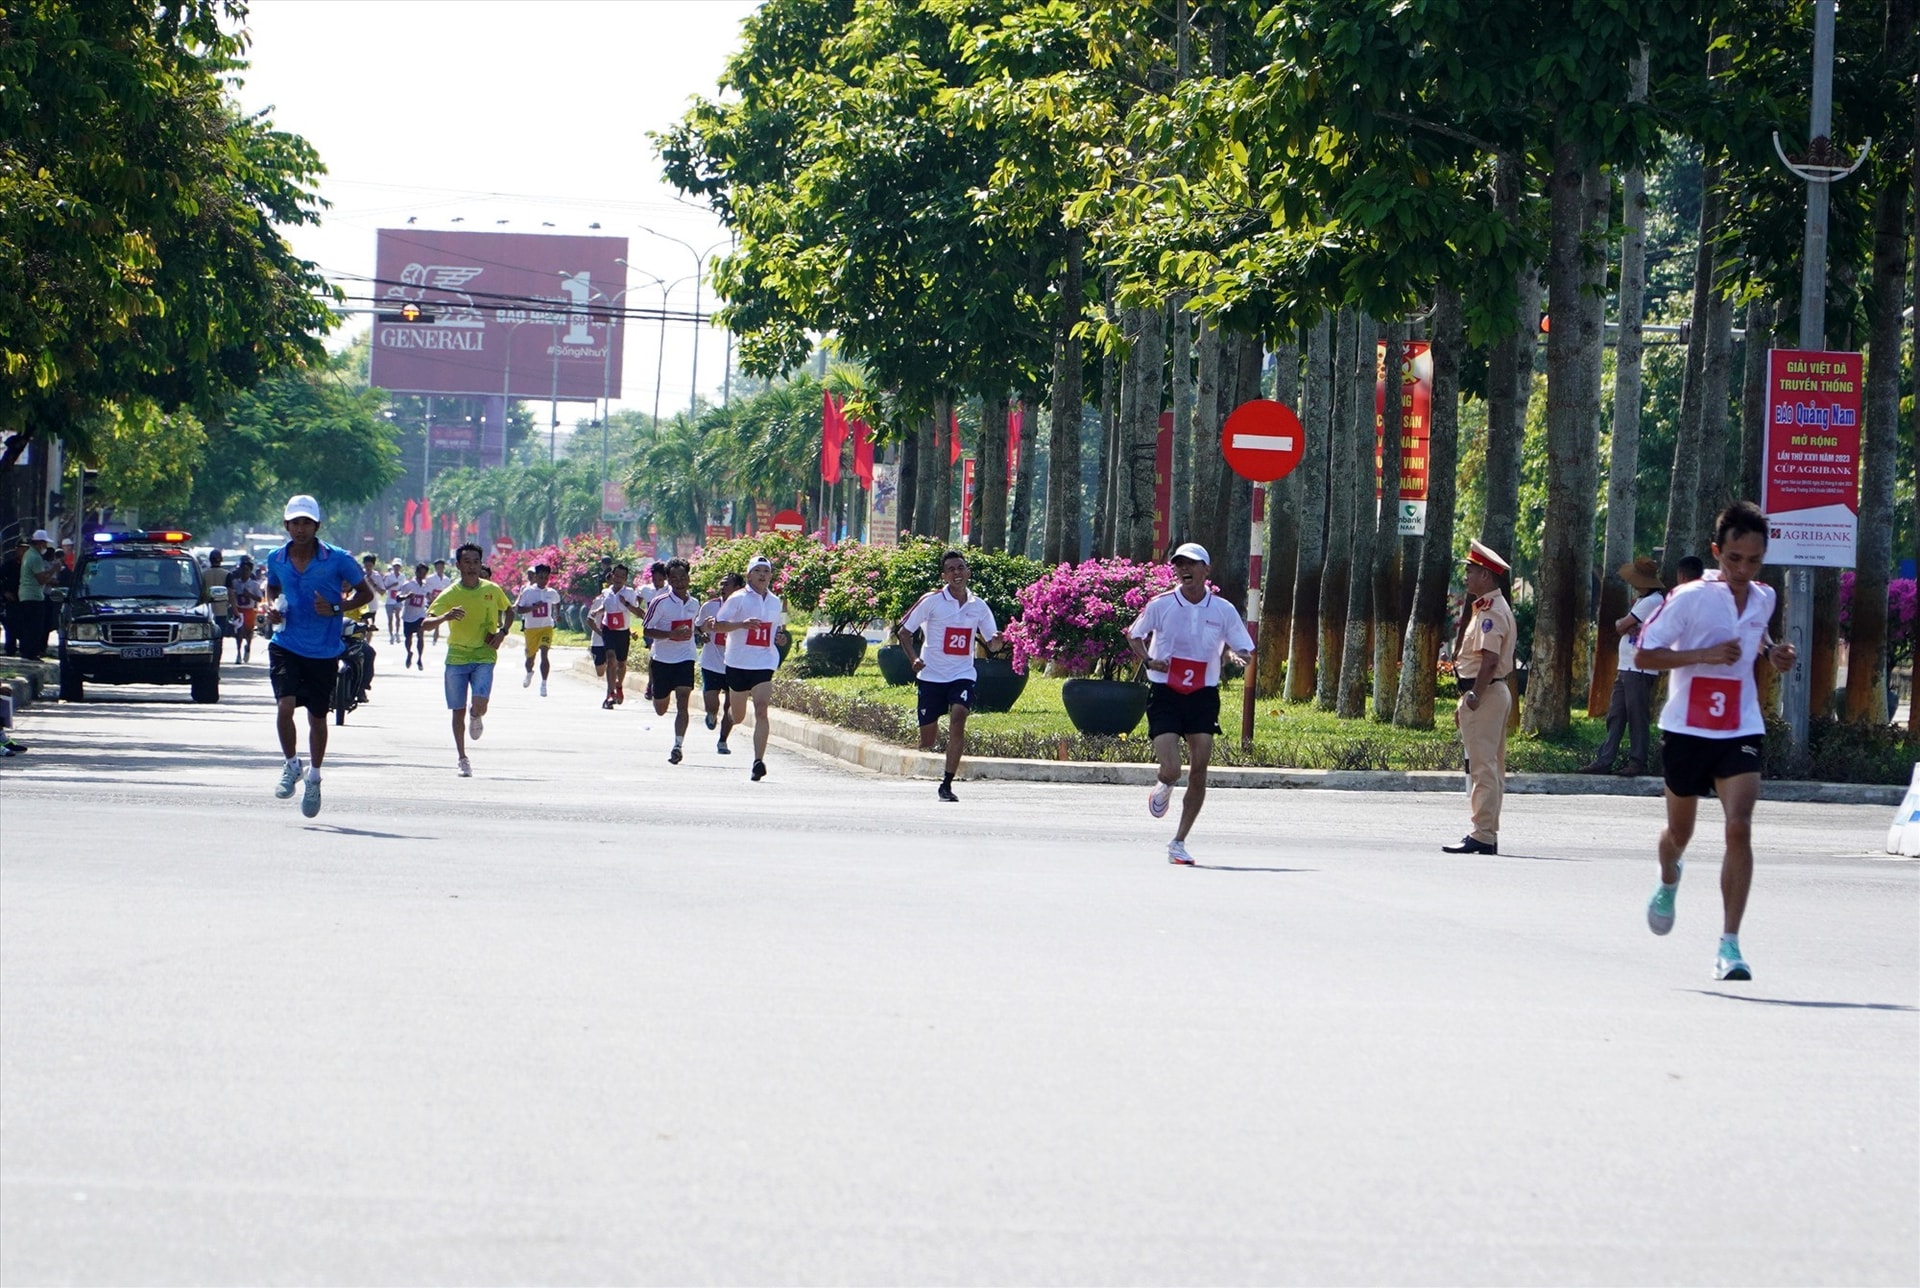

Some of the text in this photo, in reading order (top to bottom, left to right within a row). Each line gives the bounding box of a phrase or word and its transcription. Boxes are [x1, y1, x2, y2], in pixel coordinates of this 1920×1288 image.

[561, 271, 594, 345] 1
[380, 328, 484, 351] GENERALI
[1787, 359, 1807, 373] GIẢI
[1809, 361, 1831, 376] VIỆT
[1820, 377, 1853, 393] THỐNG
[1403, 411, 1423, 429] SẢN
[1796, 400, 1830, 430] Quảng
[1831, 403, 1855, 426] Nam
[1791, 434, 1838, 448] MỞ RỘNG
[1403, 457, 1425, 470] VINH
[1774, 462, 1852, 475] CÚP AGRIBANK
[1783, 530, 1851, 541] AGRIBANK
[754, 628, 768, 641] 11
[948, 635, 967, 649] 26
[1182, 669, 1195, 687] 2
[960, 690, 968, 702] 4
[1709, 692, 1726, 717] 3
